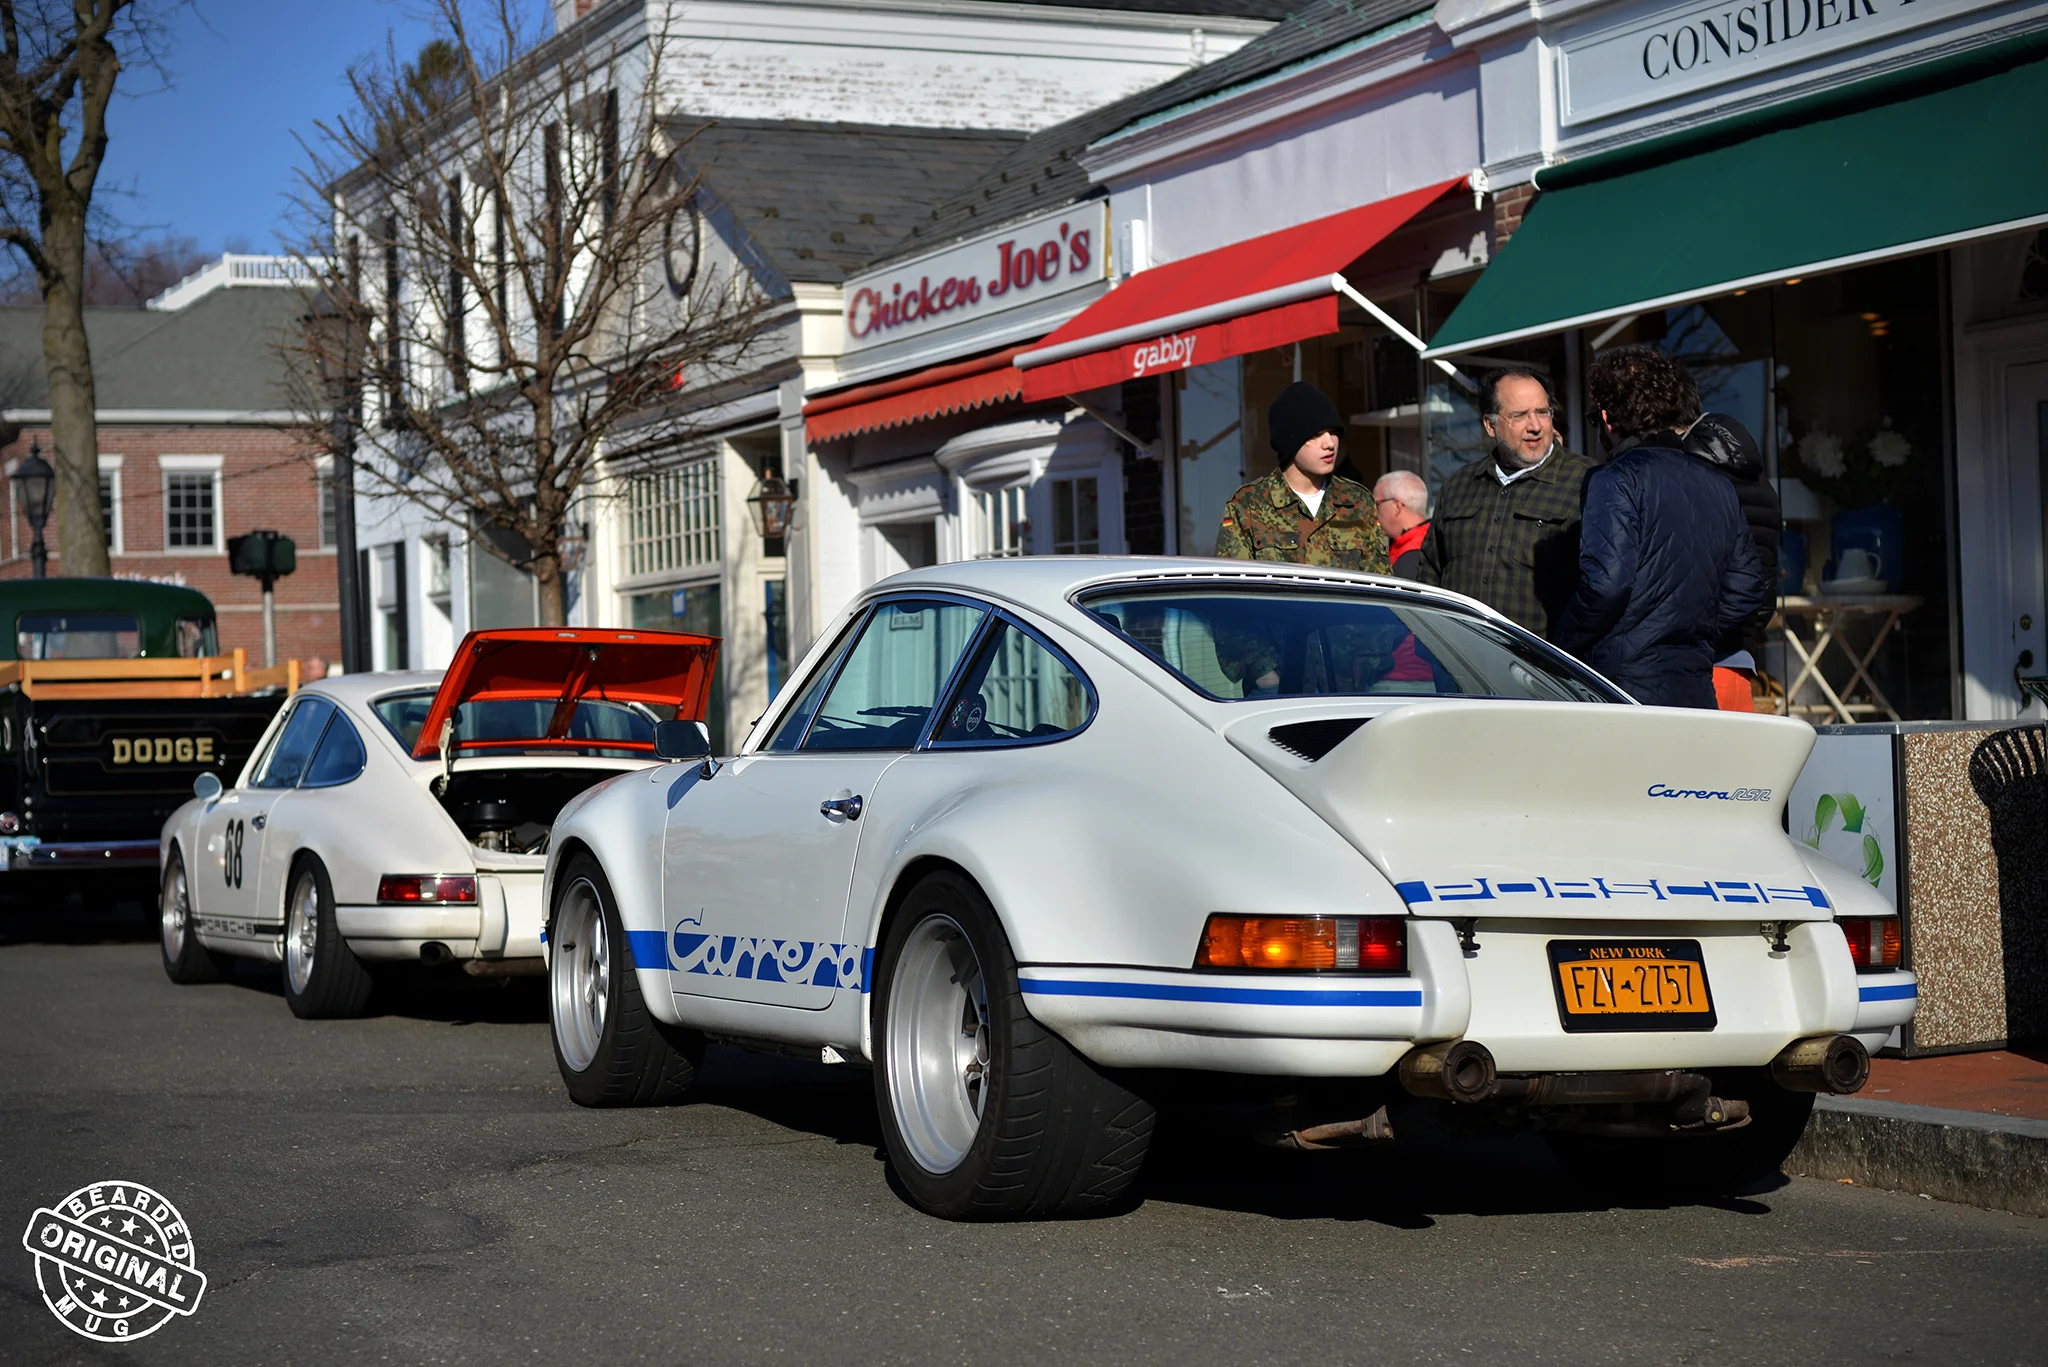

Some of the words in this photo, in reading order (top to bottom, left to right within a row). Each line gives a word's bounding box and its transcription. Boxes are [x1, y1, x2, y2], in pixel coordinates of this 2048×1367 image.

[848, 276, 980, 338] Chicken
[988, 222, 1090, 296] Joe's
[1133, 334, 1196, 377] gabby
[112, 738, 214, 764] DODGE
[1648, 784, 1729, 800] Carrera
[1730, 788, 1772, 801] RSR
[224, 818, 244, 890] 68
[1428, 877, 1812, 905] PORSCHE
[199, 917, 255, 936] PORSCHE
[667, 908, 864, 989] Carrera
[1590, 947, 1623, 959] NEW
[1627, 947, 1666, 959] YORK
